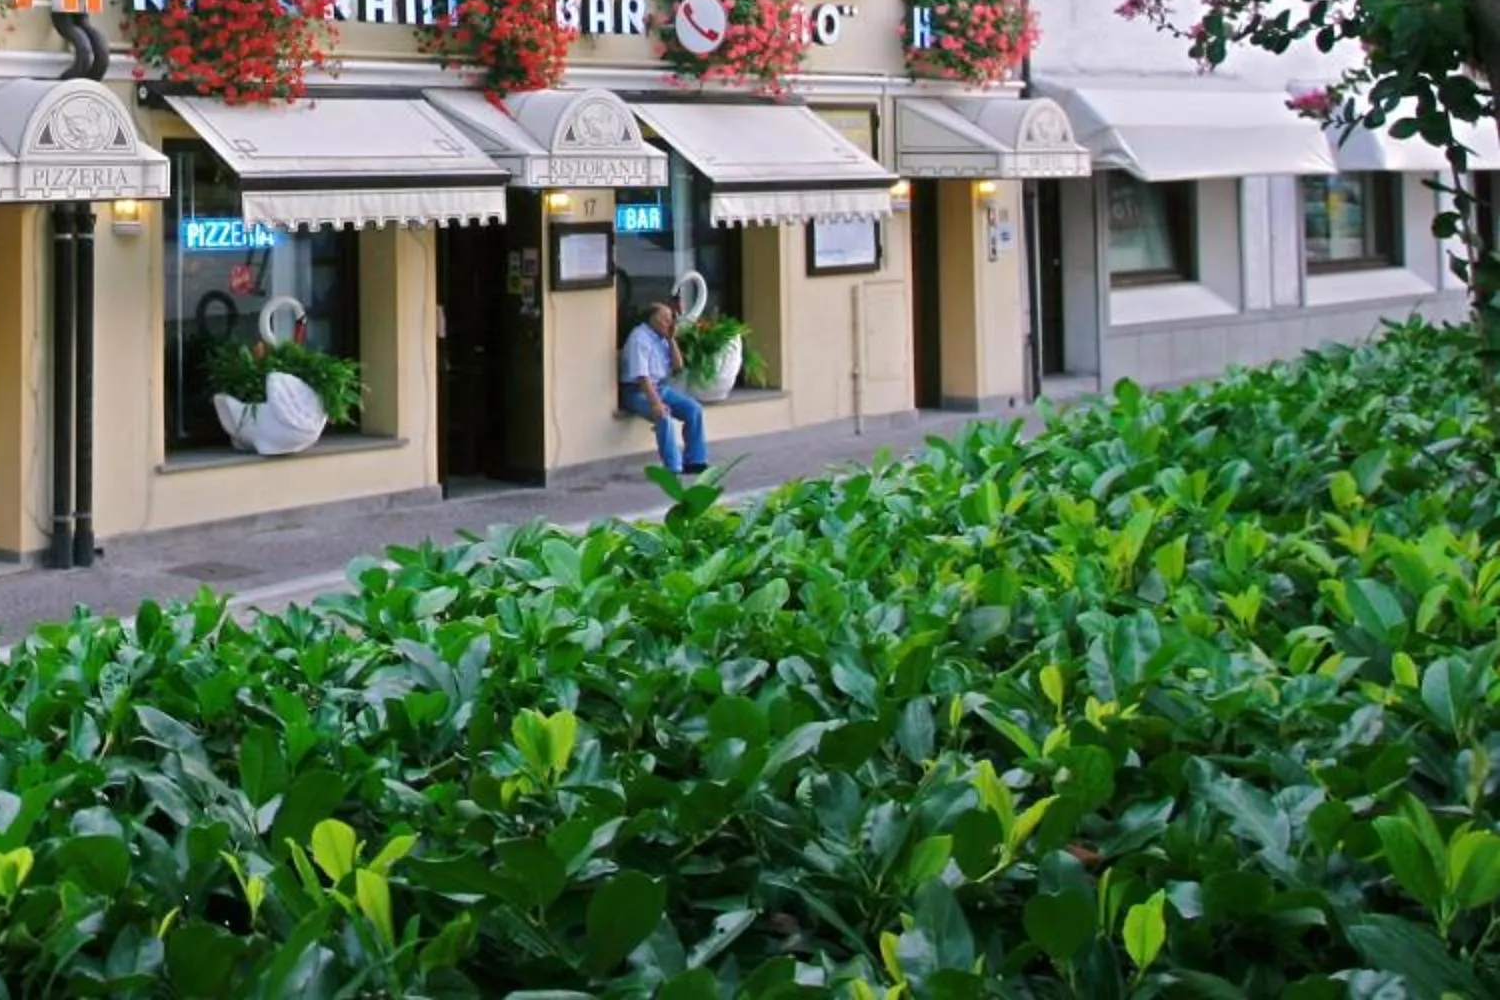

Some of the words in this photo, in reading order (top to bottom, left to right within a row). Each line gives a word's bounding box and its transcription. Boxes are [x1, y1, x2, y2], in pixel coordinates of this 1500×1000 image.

[32, 166, 130, 187] PIZZERIA
[583, 198, 597, 217] 17
[626, 206, 661, 230] BAR
